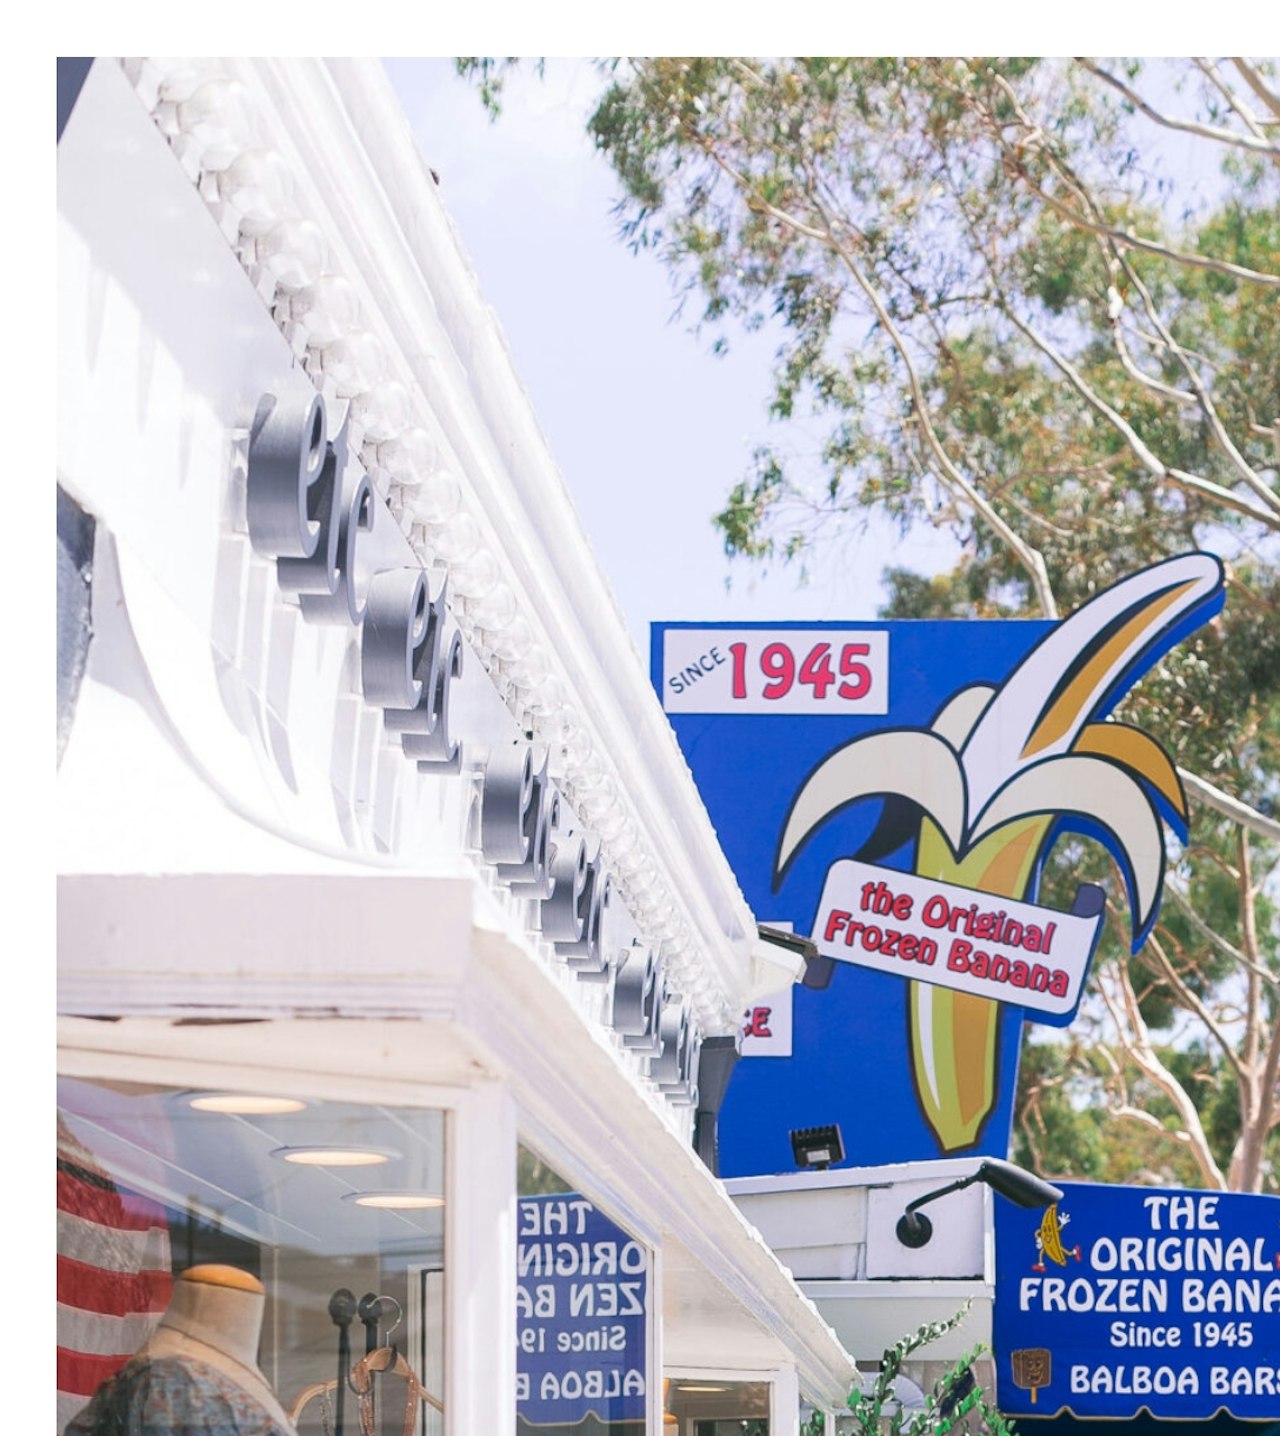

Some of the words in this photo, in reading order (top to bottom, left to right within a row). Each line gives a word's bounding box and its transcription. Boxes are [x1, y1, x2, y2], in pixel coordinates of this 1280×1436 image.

[668, 646, 726, 694] SINCE
[729, 642, 872, 700] 1945
[860, 881, 913, 920] the
[922, 895, 1057, 955] Original
[824, 909, 938, 966] Frozen
[947, 938, 1070, 998] Banana
[1144, 1196, 1220, 1230] THE
[1090, 1237, 1274, 1271] ORIGINAL
[1019, 1278, 1168, 1312] FROZEN
[1110, 1321, 1180, 1348] Since
[1193, 1321, 1254, 1348] 1945
[1070, 1365, 1199, 1395] BALBOA
